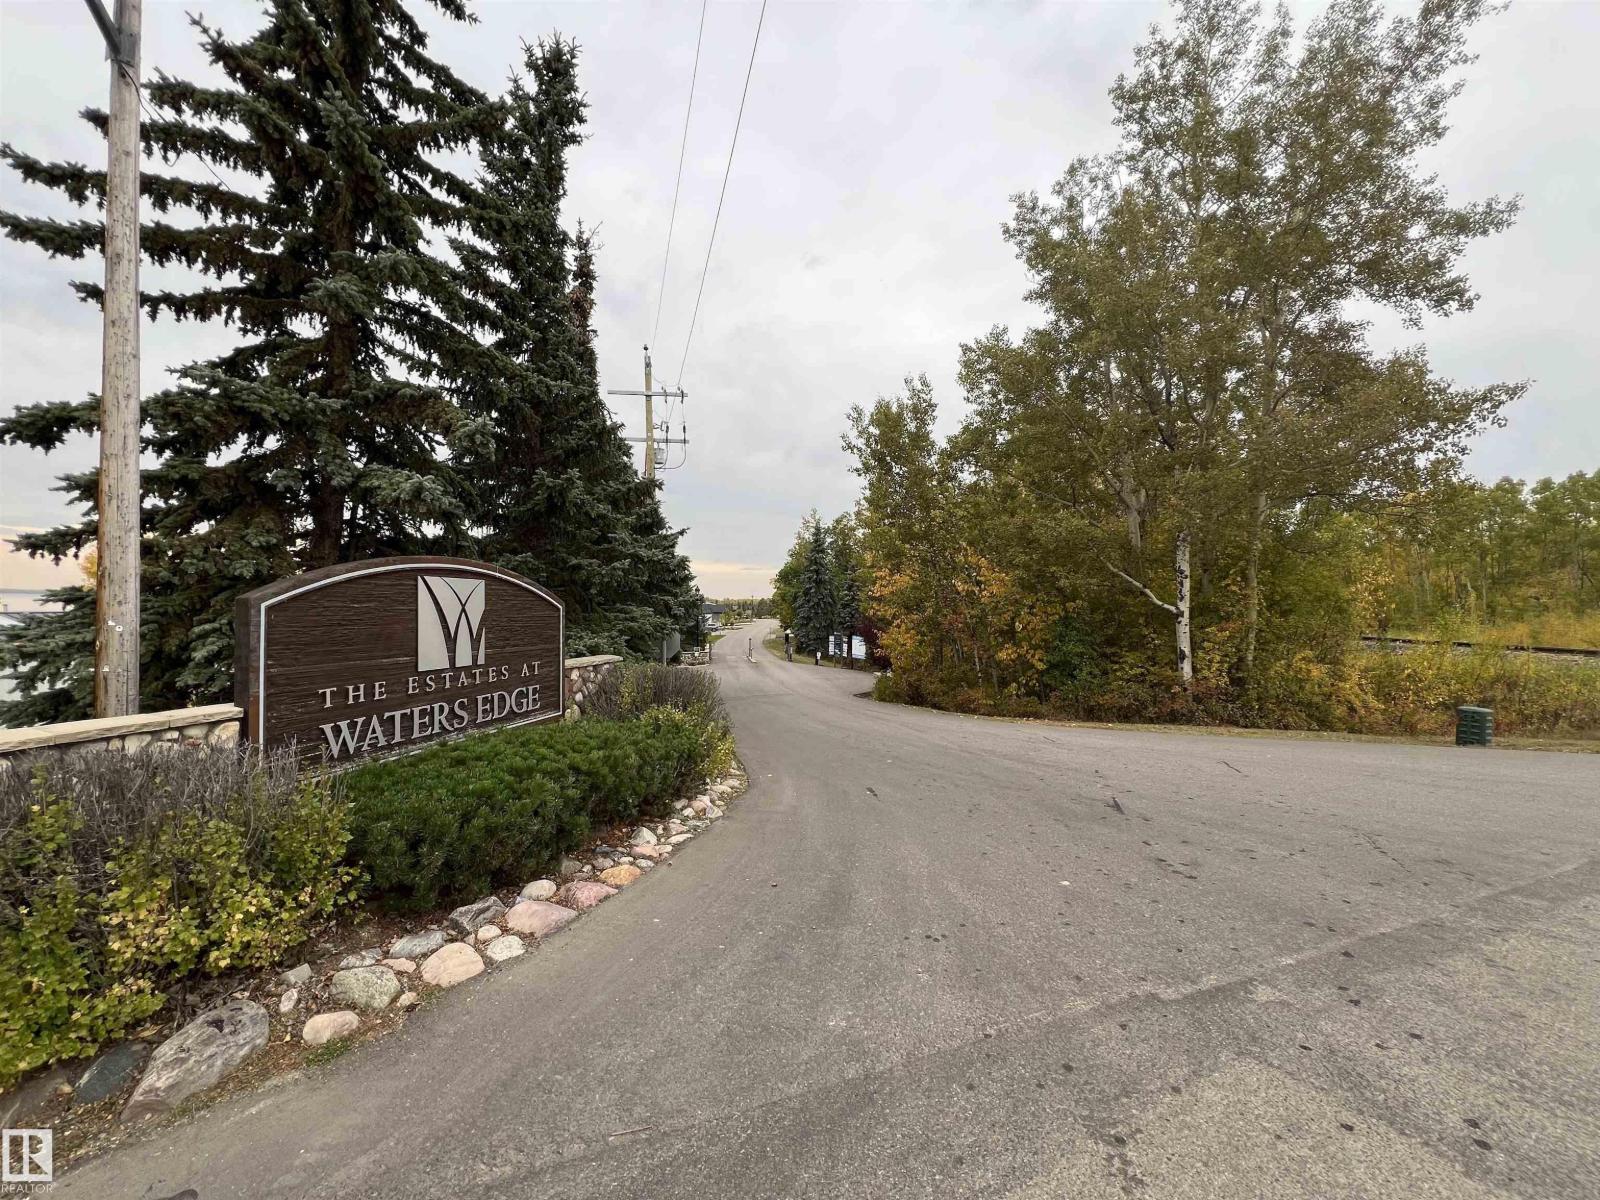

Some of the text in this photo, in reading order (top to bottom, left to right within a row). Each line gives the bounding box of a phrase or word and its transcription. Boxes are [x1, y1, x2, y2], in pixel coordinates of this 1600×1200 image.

[318, 661, 541, 708] THE ESTATES AT
[319, 685, 541, 759] WATERS EDGE
